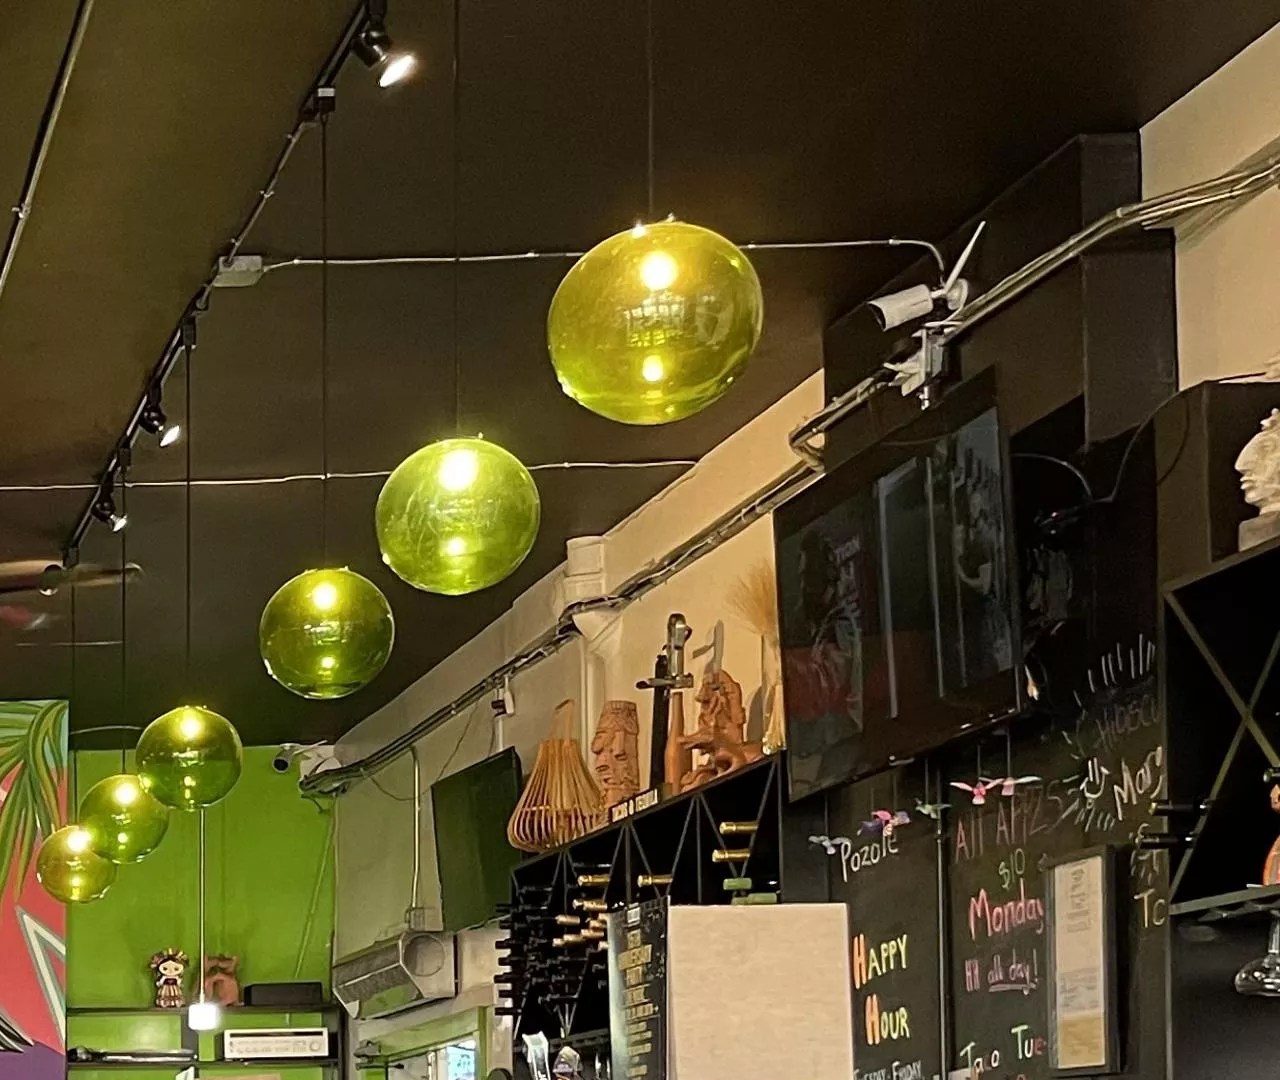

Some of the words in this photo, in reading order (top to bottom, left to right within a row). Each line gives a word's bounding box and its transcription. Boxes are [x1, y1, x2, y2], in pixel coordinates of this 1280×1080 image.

[840, 824, 899, 883] Pozole
[998, 848, 1026, 890] $10
[968, 877, 1044, 940] Monday
[853, 933, 907, 990] HAPPY
[987, 954, 1003, 984] all
[866, 993, 910, 1045] HOUR
